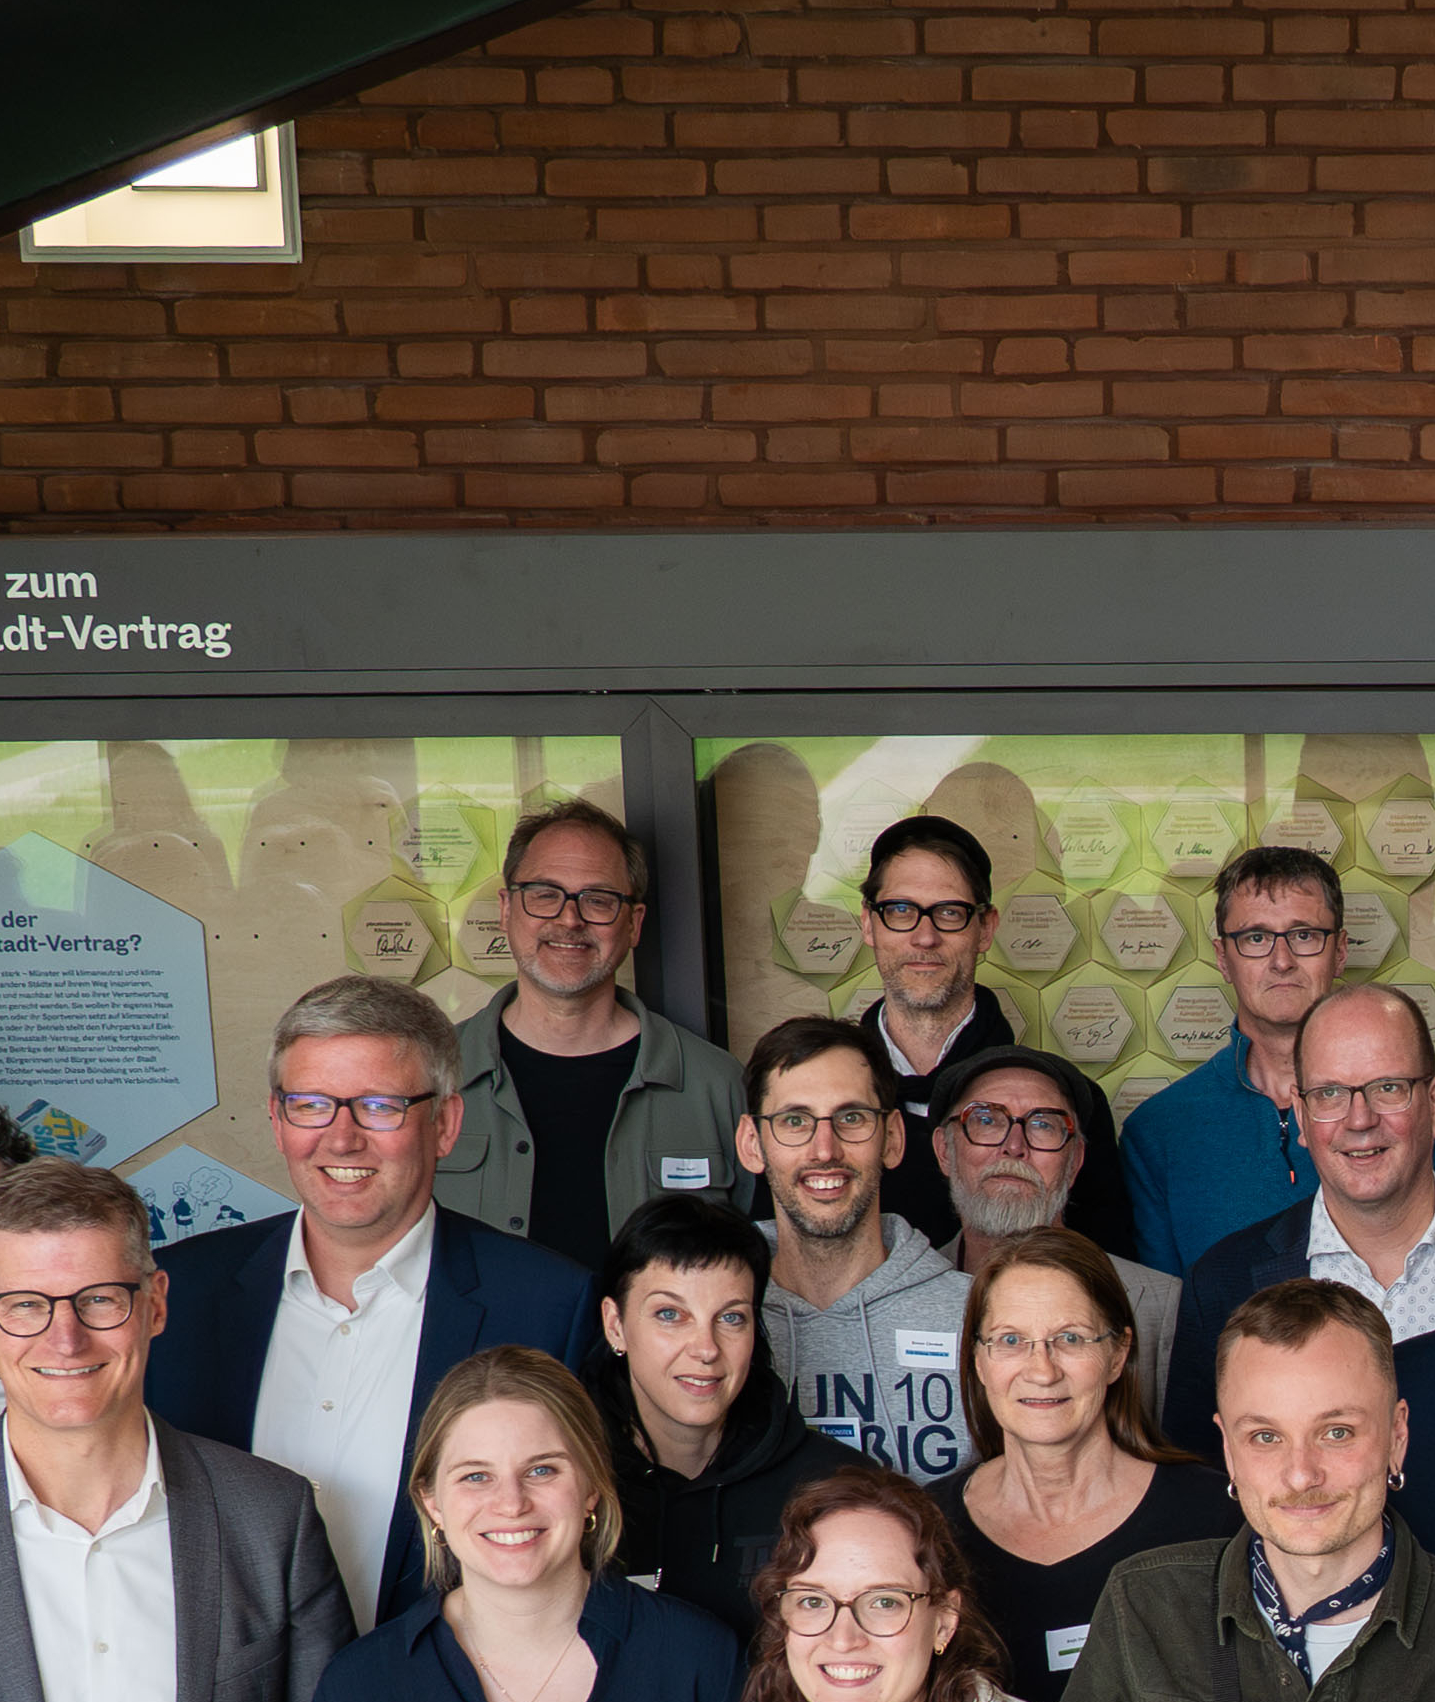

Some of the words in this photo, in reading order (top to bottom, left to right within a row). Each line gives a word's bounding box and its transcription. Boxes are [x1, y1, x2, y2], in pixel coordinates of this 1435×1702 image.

[5, 571, 98, 599] zum
[1, 911, 38, 928] der
[895, 1372, 953, 1422] 10
